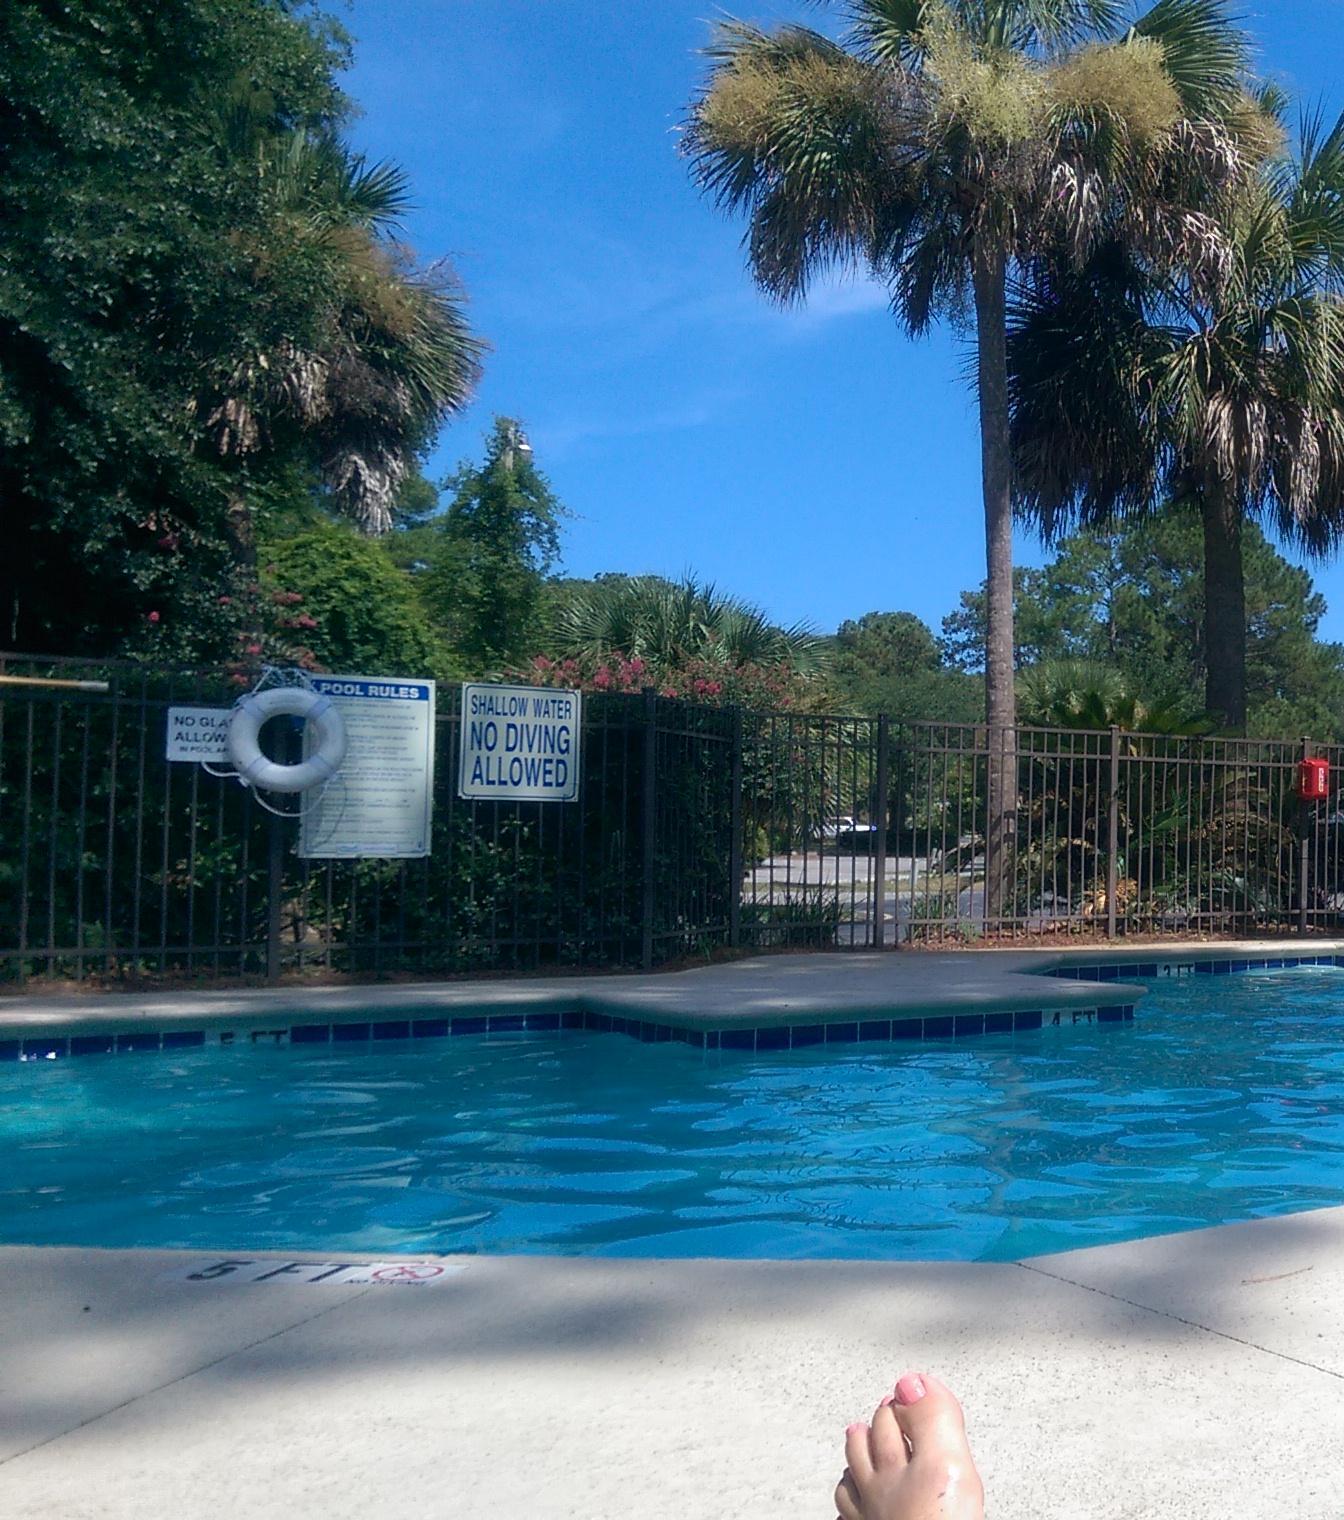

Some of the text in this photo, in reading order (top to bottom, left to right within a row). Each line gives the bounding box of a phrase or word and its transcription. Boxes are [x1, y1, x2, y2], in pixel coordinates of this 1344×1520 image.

[320, 683, 420, 699] POOL RULES
[471, 694, 572, 719] SHALLOW WATER
[174, 716, 233, 728] NO GLA
[175, 732, 228, 742] ALLOW
[470, 721, 570, 754] NO DIVING
[470, 755, 568, 787] ALLOWED
[1072, 1010, 1096, 1024] FT
[186, 1260, 255, 1281] 5
[251, 1262, 370, 1283] FT
